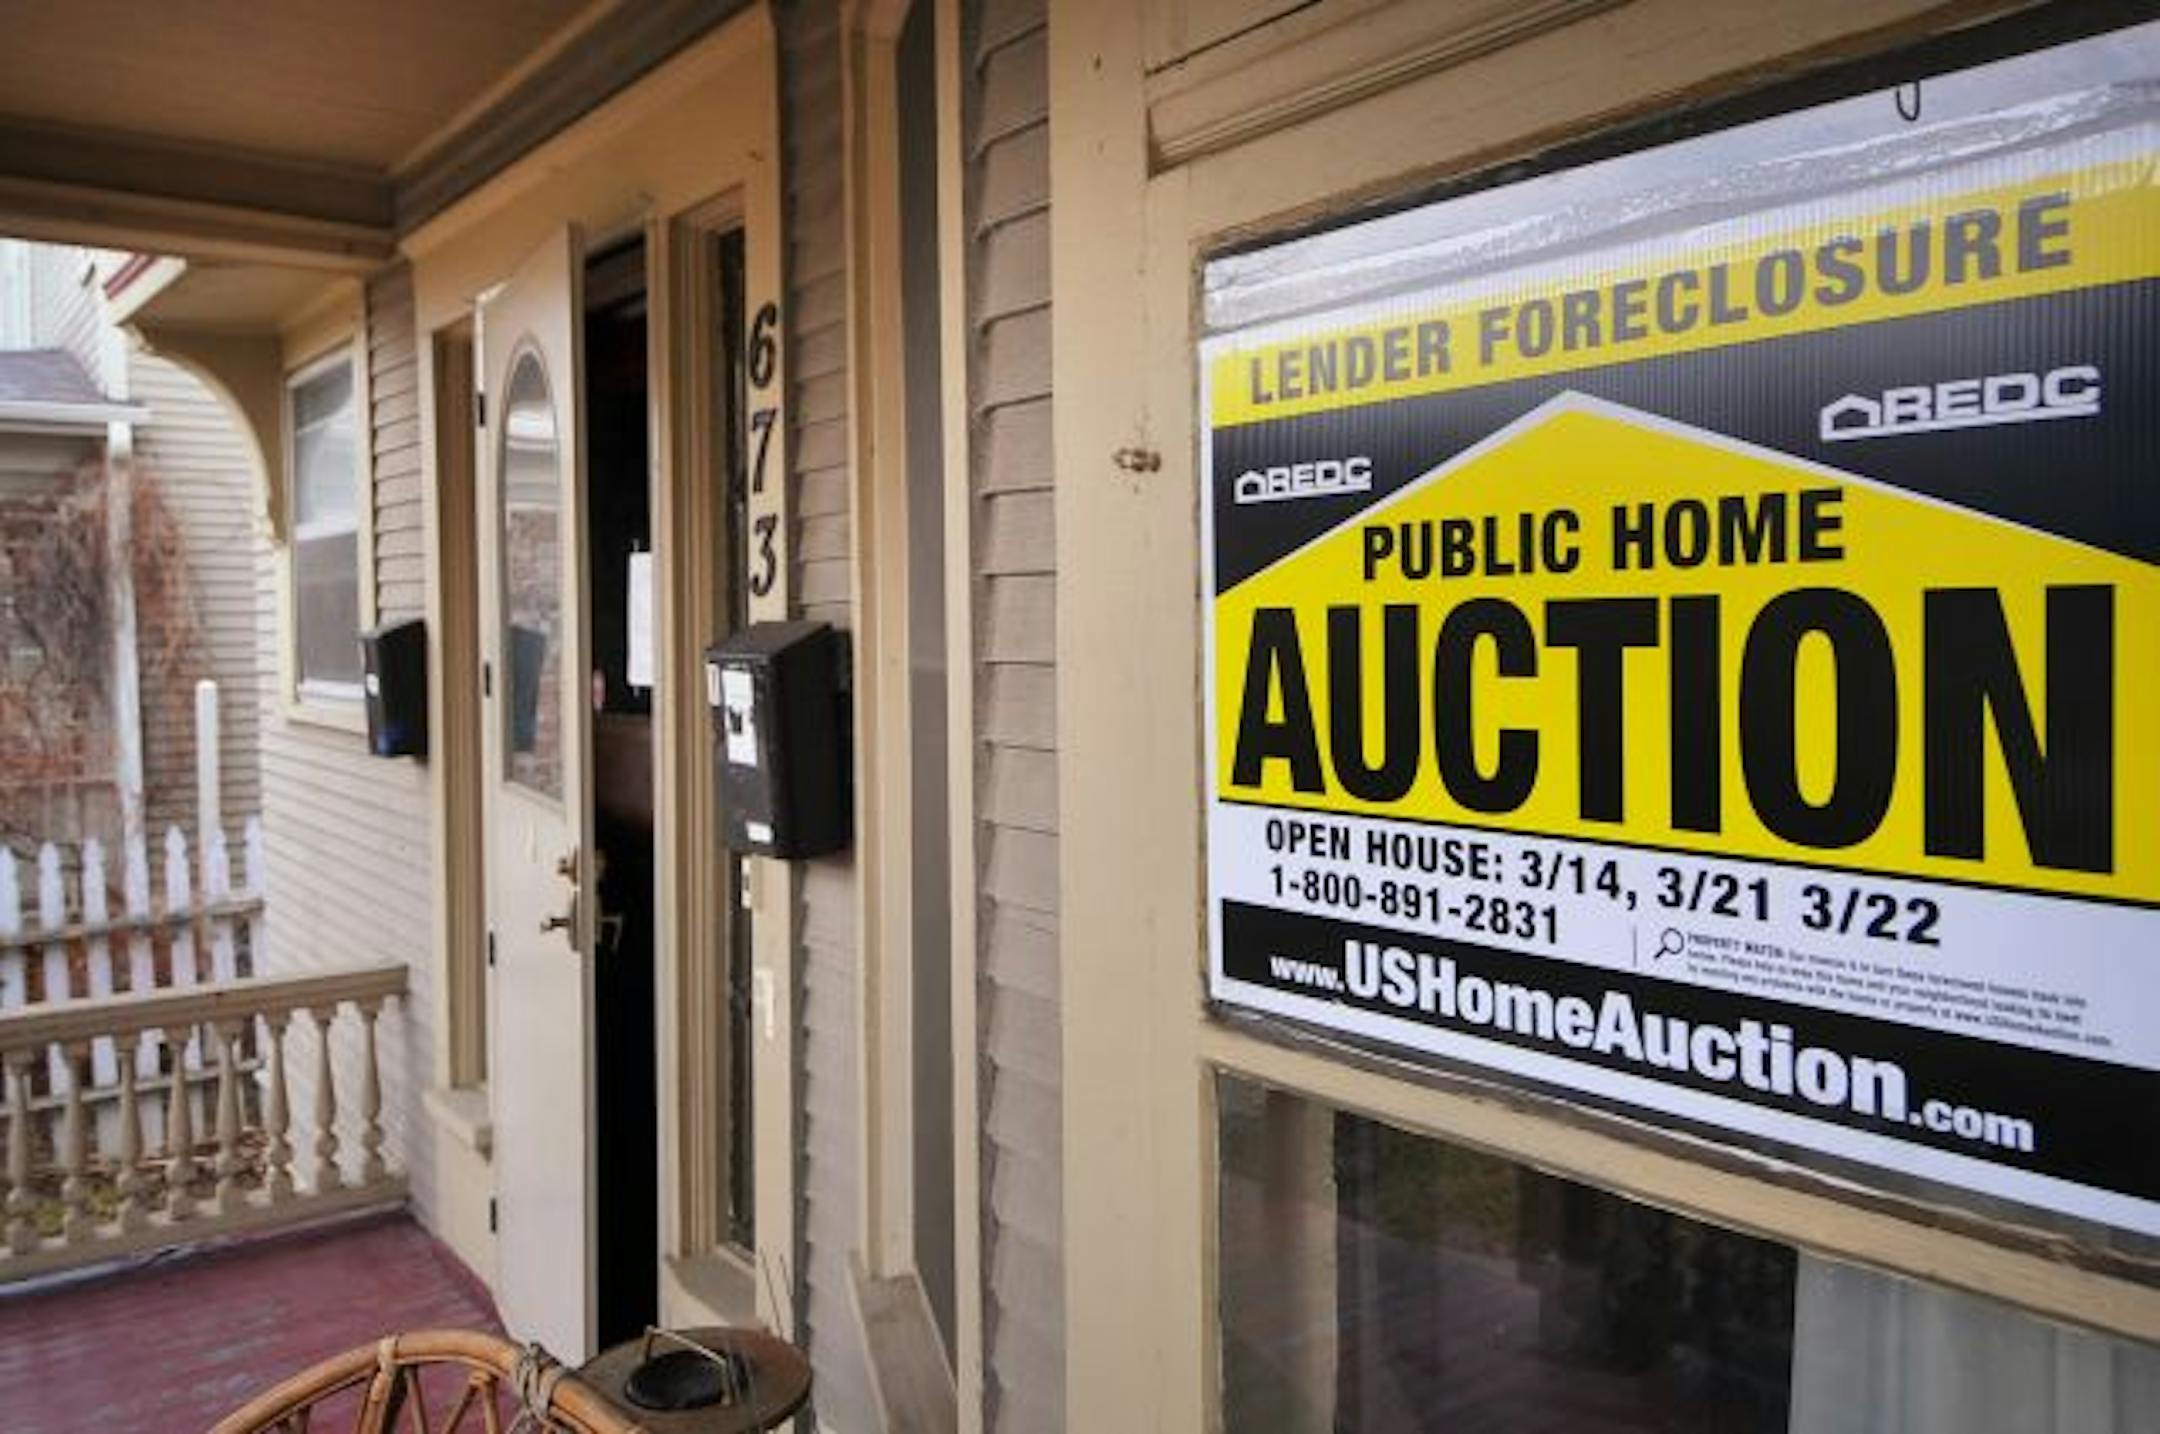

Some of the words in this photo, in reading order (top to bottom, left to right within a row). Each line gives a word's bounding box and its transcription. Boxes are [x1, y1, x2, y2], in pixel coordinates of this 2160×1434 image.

[1249, 327, 1453, 406] LENDER
[1480, 190, 2073, 367] FORECLOSURE
[747, 302, 778, 599] 673
[1881, 366, 2100, 426] REDC
[1266, 457, 1372, 494] REDC
[1362, 509, 1580, 581] PUBLIC
[1614, 487, 1844, 571] HOME
[1231, 584, 2116, 875] AUCTION
[1266, 819, 1350, 861] OPEN
[1367, 829, 1503, 883] HOUSE:
[1519, 849, 1638, 909] 3/14,
[1657, 867, 1770, 922] 3/21
[1802, 884, 1941, 947] 3/22
[1270, 864, 1557, 944] 1-800-891-2831
[1269, 938, 2034, 1152] www.USHomeAuction.com
